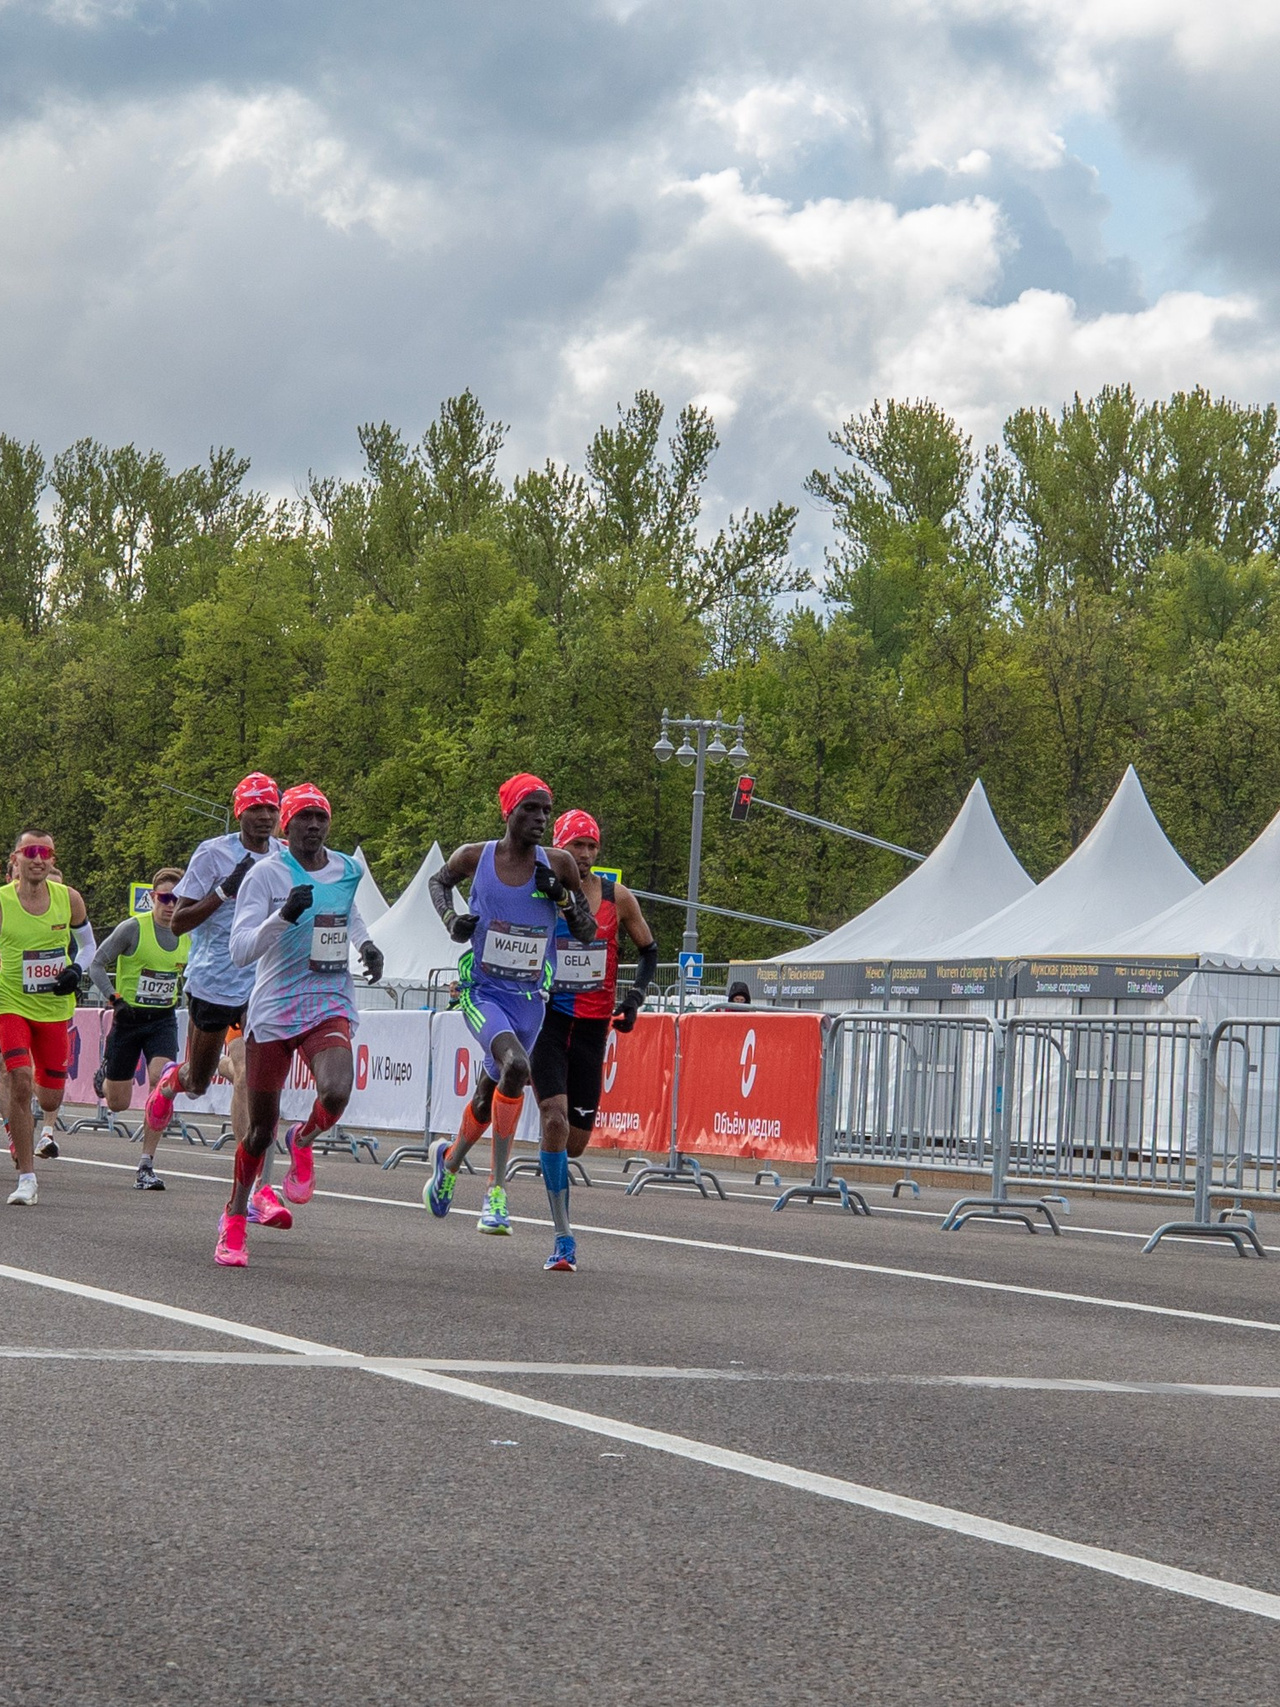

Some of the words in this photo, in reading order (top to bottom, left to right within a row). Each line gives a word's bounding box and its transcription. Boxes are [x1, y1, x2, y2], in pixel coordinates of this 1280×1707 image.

[495, 937, 538, 955] WAFULA
[564, 954, 591, 967] GELA
[936, 965, 958, 978] Women
[960, 965, 987, 981] changing
[1030, 962, 1059, 978] Мужская
[1060, 964, 1099, 979] раздевалка
[141, 980, 176, 994] 10738
[951, 983, 963, 994] Elite
[964, 983, 985, 994] athletes
[1127, 981, 1140, 993] Elite
[1141, 981, 1164, 995] athletes
[372, 1056, 383, 1081] VK
[385, 1056, 412, 1086] Видео
[608, 1112, 640, 1132] медиа
[714, 1111, 745, 1134] Объём
[747, 1117, 781, 1142] медиа
